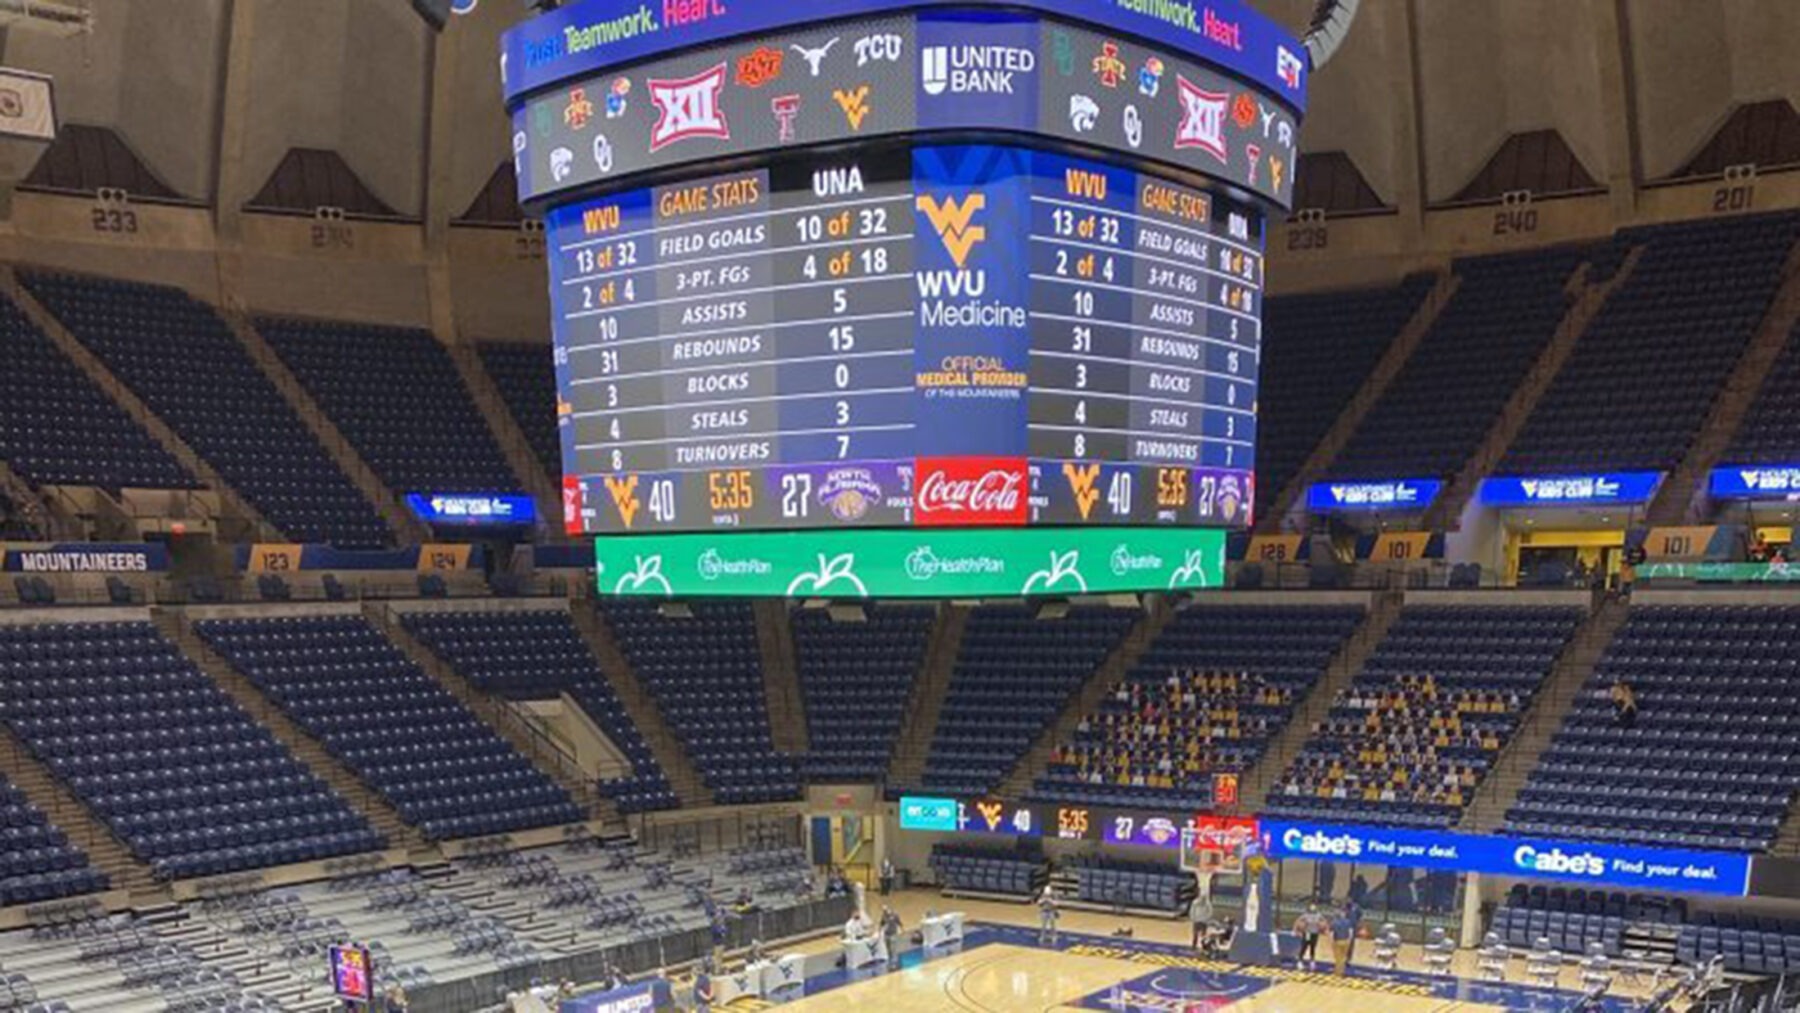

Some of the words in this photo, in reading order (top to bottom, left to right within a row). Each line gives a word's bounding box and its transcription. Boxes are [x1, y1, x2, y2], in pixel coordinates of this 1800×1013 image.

[564, 8, 659, 55] Teamwork.
[1203, 7, 1242, 51] Heart.
[854, 35, 902, 66] TCU
[951, 45, 1035, 72] UNITED
[951, 70, 1014, 95] BANK
[812, 165, 865, 197] UNA
[1065, 168, 1107, 200] WVU
[659, 183, 708, 217] GAME
[711, 178, 760, 210] STATS
[1141, 184, 1180, 216] GAME
[1713, 186, 1754, 212] 201
[91, 207, 138, 233] 233
[583, 205, 621, 234] WVU
[796, 215, 822, 243] 10
[828, 212, 851, 236] of
[859, 207, 888, 235] 32
[1051, 208, 1074, 236] 13
[1077, 215, 1096, 239] of
[1100, 217, 1119, 244] 32
[1493, 210, 1538, 236] 240
[659, 230, 704, 257] FIELD
[708, 224, 766, 249] GOALS
[1138, 229, 1173, 252] FIELD
[1174, 236, 1208, 261] GOALS
[576, 248, 595, 274] 13
[597, 245, 613, 269] of
[617, 241, 637, 267] 32
[803, 254, 817, 279] 4
[828, 251, 851, 276] of
[861, 247, 888, 274] 18
[1056, 250, 1067, 275] 2
[1077, 253, 1095, 277] of
[1103, 257, 1114, 283] 4
[676, 271, 713, 292] 3-PT.
[917, 269, 985, 298] WVU
[1148, 266, 1173, 290] 3-PT.
[582, 285, 593, 309] 2
[599, 280, 615, 304] of
[623, 277, 635, 301] 4
[832, 288, 848, 313] 5
[1073, 290, 1094, 317] 10
[682, 301, 748, 325] ASSISTS
[920, 300, 1027, 329] Medicine
[1149, 303, 1195, 327] ASSISTS
[599, 316, 618, 341] 10
[828, 325, 855, 352] 15
[1072, 326, 1092, 353] 31
[672, 335, 762, 361] REBOUNDS
[1139, 335, 1201, 361] REBOUNDS
[602, 350, 619, 374] 31
[941, 356, 1005, 371] OFFICIAL
[687, 372, 749, 394] BLOCKS
[835, 363, 849, 388] 0
[916, 371, 970, 388] MEDICAL
[1075, 364, 1088, 389] 3
[1149, 370, 1192, 393] BLOCKS
[608, 383, 618, 407] 3
[691, 409, 749, 430] STEALS
[836, 401, 850, 425] 3
[1074, 400, 1086, 425] 4
[1149, 408, 1189, 428] STEALS
[609, 417, 621, 440] 4
[676, 441, 771, 464] TURNOVERS
[837, 435, 850, 459] 7
[1074, 434, 1087, 458] 8
[1134, 441, 1199, 461] TURNOVERS
[612, 448, 623, 471] 8
[648, 479, 676, 522] 40
[708, 470, 754, 511] 5:35
[781, 473, 812, 518] 27
[918, 470, 1023, 513] Coca-Cola
[1106, 472, 1132, 516] 40
[1386, 540, 1413, 559] 101
[1663, 536, 1691, 555] 101
[20, 552, 148, 572] MOUNTAINEERS
[261, 552, 290, 571] 123
[430, 552, 457, 569] 124
[1012, 808, 1031, 832] 40
[1058, 807, 1089, 832] 5:35
[1114, 816, 1134, 840] 27
[1283, 827, 1362, 856] Gabe's
[1367, 841, 1395, 855] Find
[1396, 845, 1427, 860] your
[1427, 844, 1459, 860] deal.
[1514, 844, 1605, 875] Gabe's
[1612, 860, 1644, 874] Find
[1645, 865, 1679, 880] your
[1682, 864, 1717, 880] deal.
